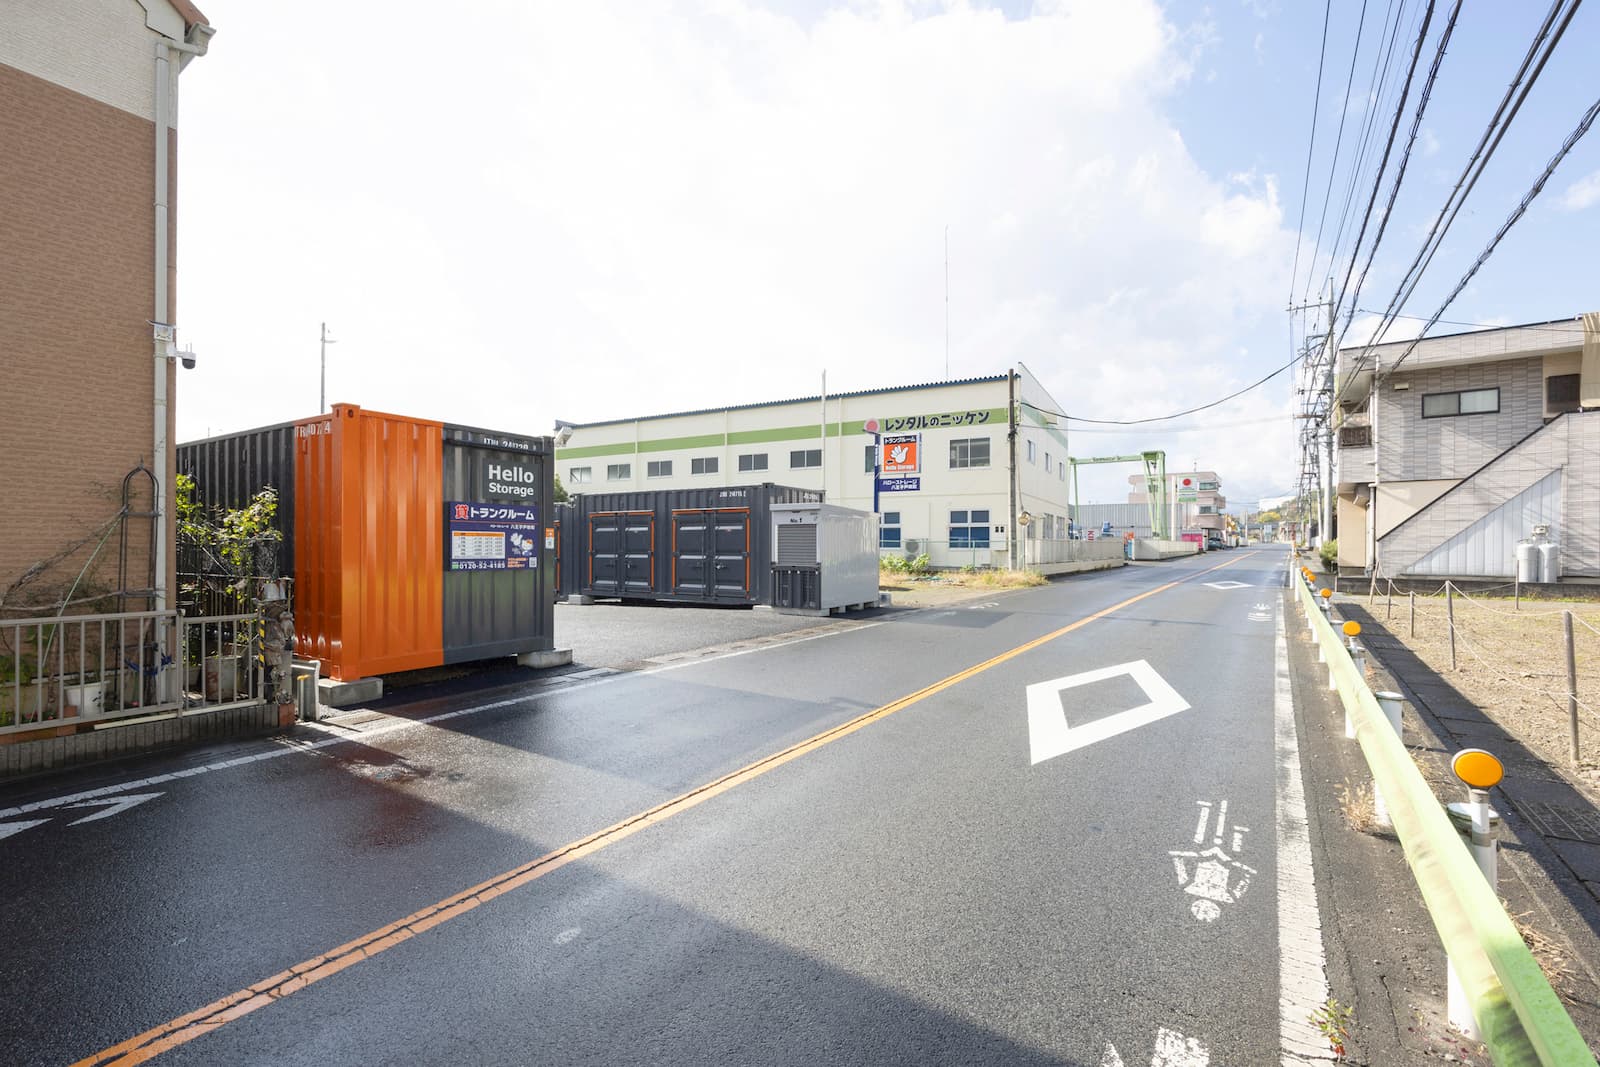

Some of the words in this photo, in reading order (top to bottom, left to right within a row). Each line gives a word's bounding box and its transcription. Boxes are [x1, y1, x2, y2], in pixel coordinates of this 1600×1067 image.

[885, 411, 990, 431] レンタルのニッケン
[488, 464, 534, 483] Hello
[488, 482, 534, 497] Storage
